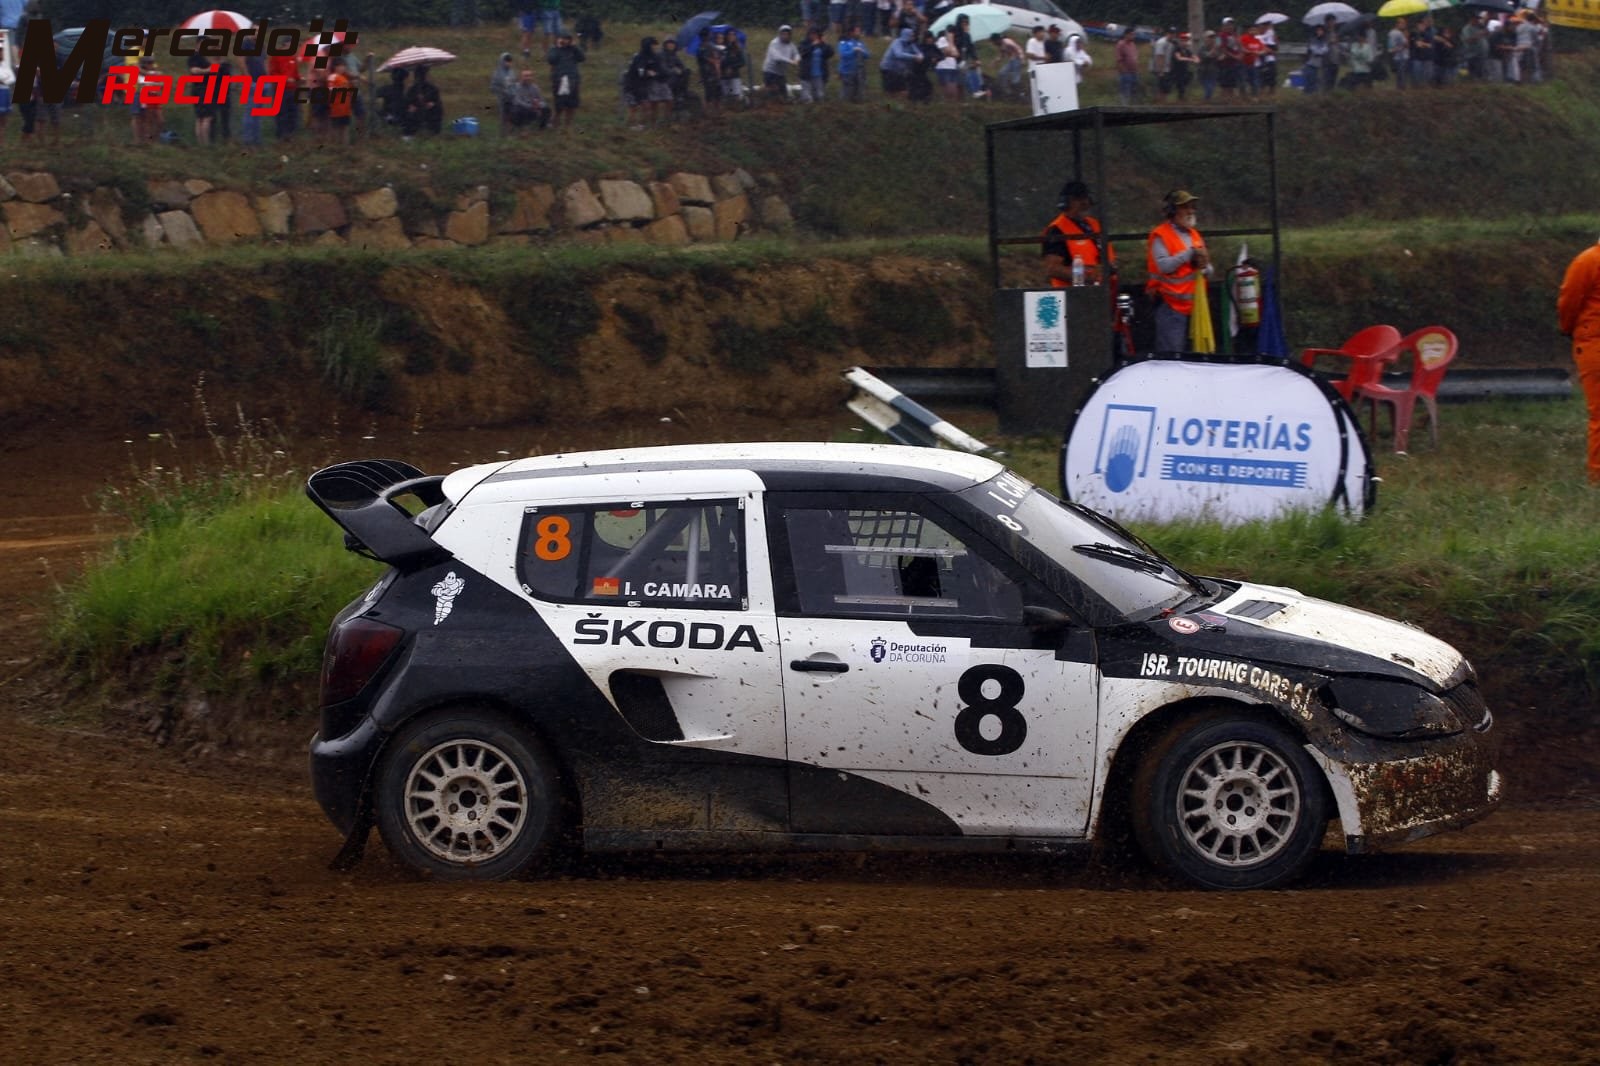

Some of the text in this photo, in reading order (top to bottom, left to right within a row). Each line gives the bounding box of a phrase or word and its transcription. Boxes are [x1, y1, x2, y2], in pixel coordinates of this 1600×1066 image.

[1165, 415, 1312, 452] LOTERÍAS
[1176, 462, 1291, 481] CON EL DEPORTE
[988, 490, 1018, 509] I.
[996, 514, 1023, 531] 8
[535, 515, 572, 561] 8
[624, 581, 732, 599] I. CAMARA
[573, 612, 764, 653] ŠKODA
[889, 652, 946, 663] DA CORUÑA
[890, 642, 947, 654] Deputación
[1177, 656, 1248, 684] TOURING
[1250, 667, 1290, 702] CARS
[954, 663, 1028, 757] 8
